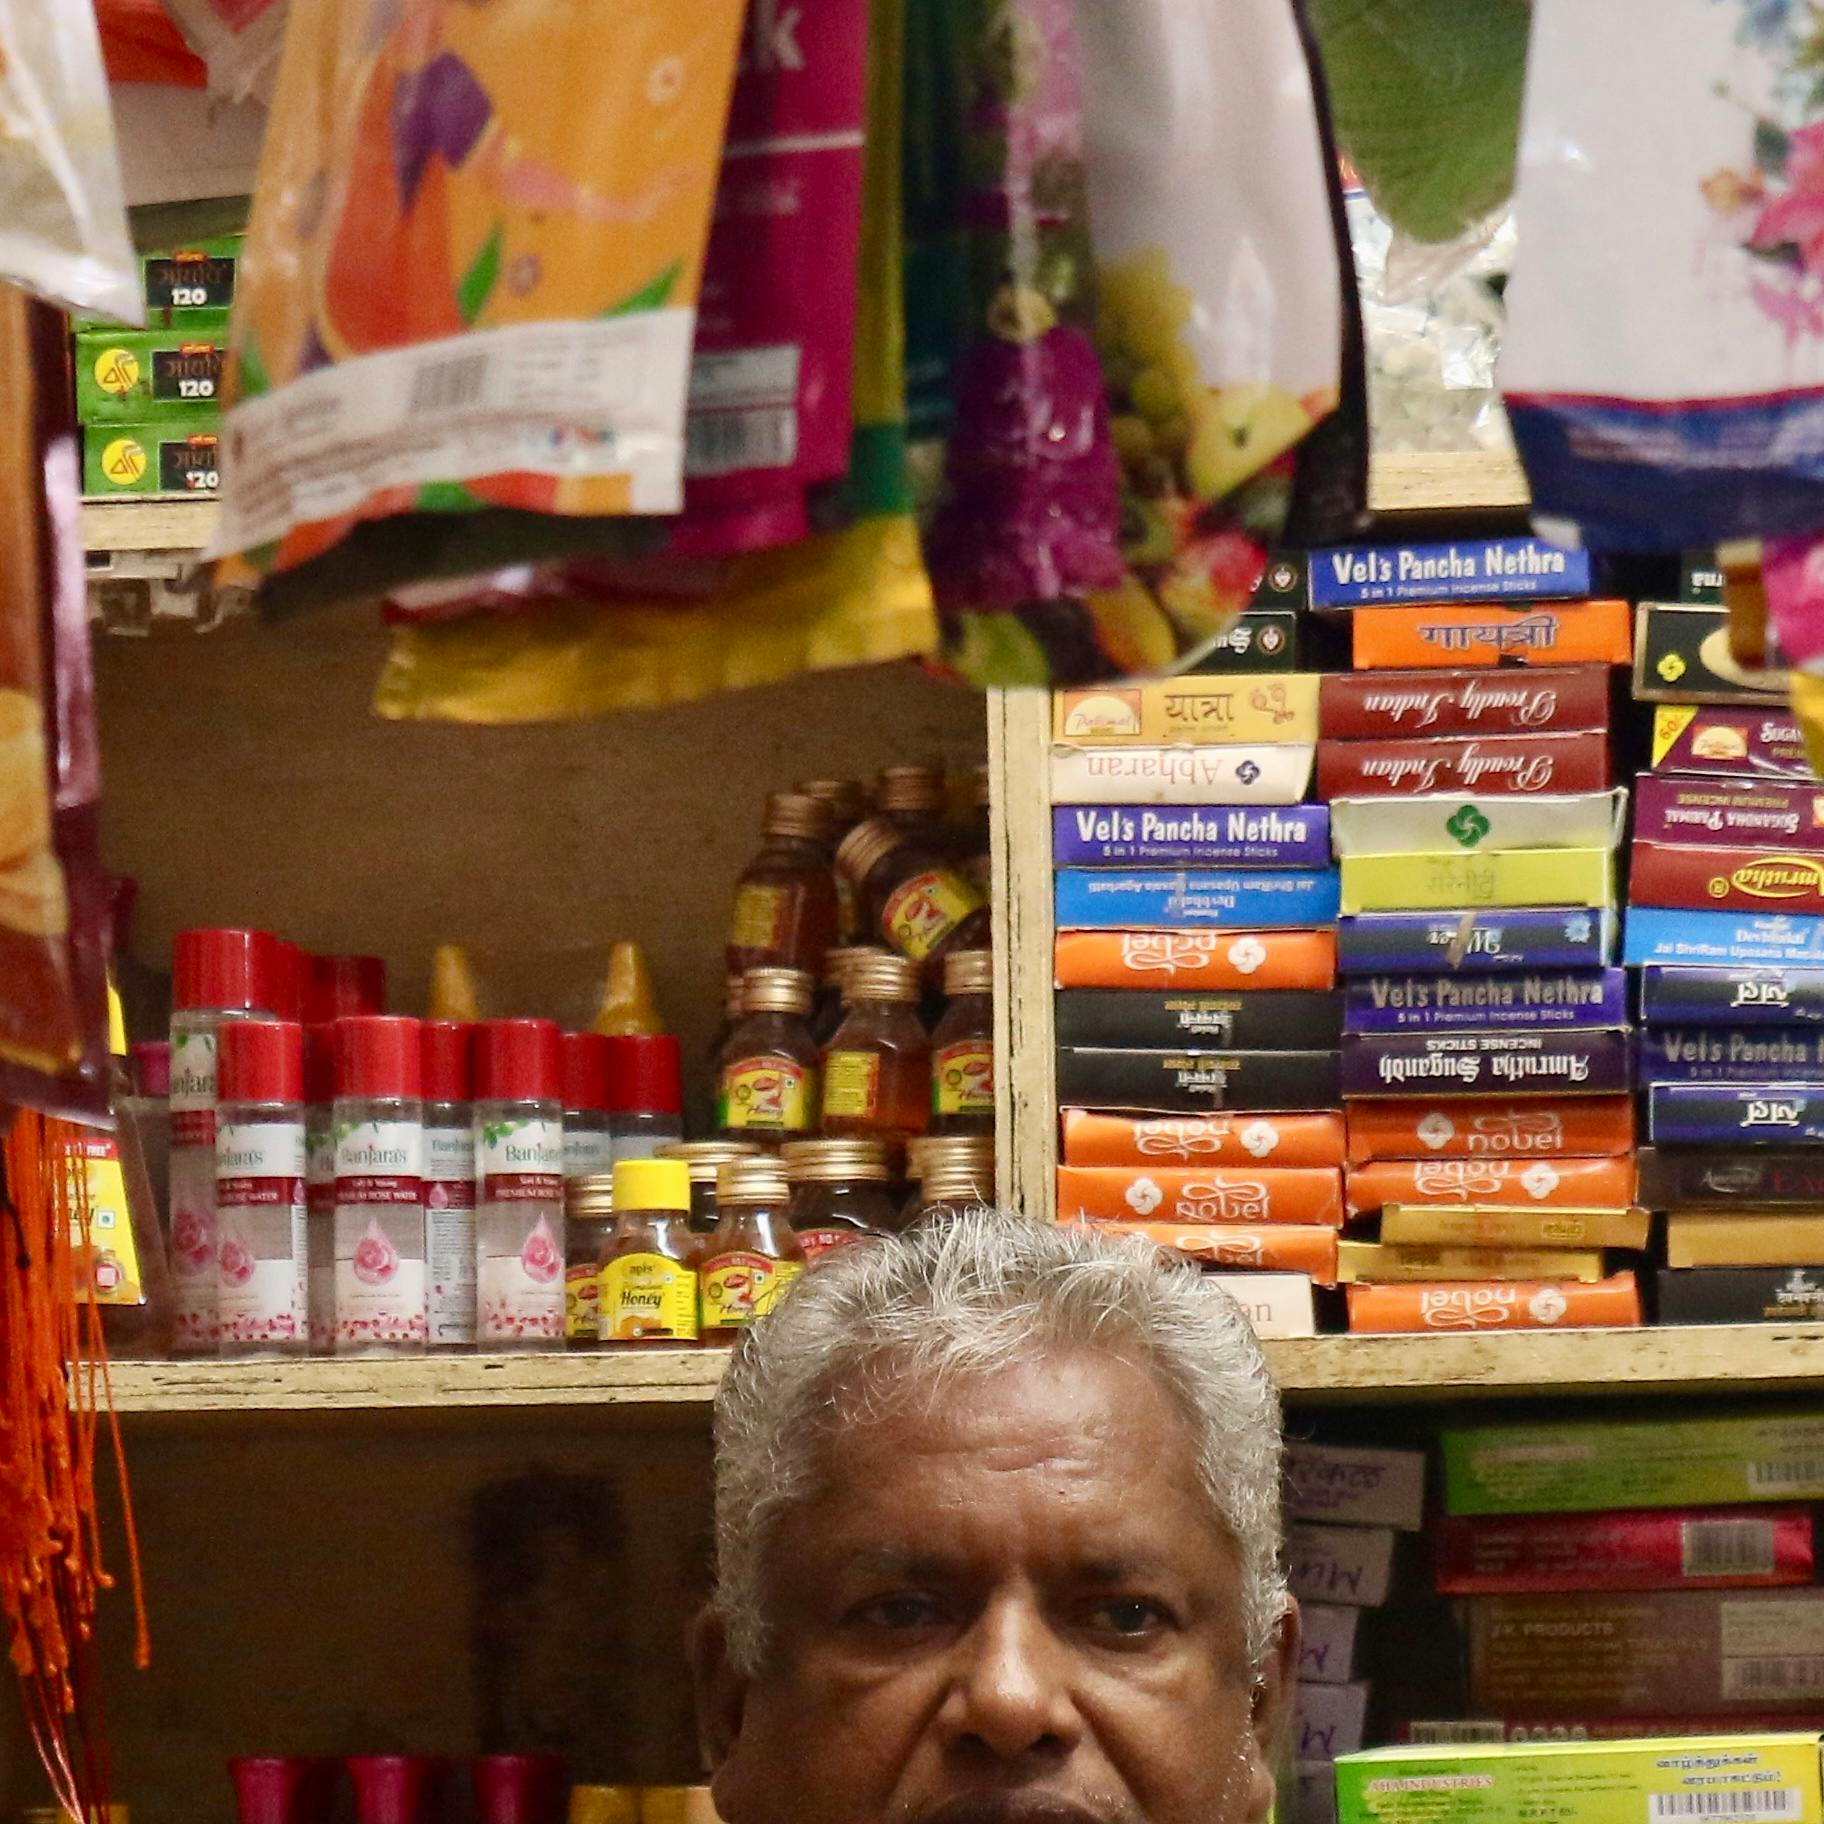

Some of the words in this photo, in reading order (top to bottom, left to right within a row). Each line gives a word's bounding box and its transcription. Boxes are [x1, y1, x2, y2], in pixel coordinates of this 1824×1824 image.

[171, 287, 208, 306] 120
[179, 379, 215, 398] 120
[186, 470, 219, 489] 120
[1332, 553, 1392, 584] Vel's
[1398, 547, 1477, 580] Pancha
[1484, 541, 1565, 576] Nethra
[1416, 612, 1560, 652] गायत्री
[1164, 692, 1234, 725] यात्रा
[1361, 688, 1451, 725] Indian
[1460, 684, 1557, 728] Proudly
[1087, 757, 1221, 786] Abharan
[1360, 752, 1449, 788] Indian
[1457, 742, 1554, 790] Proudly
[1076, 810, 1134, 843] Vel's
[1141, 811, 1218, 843] Pancha
[1226, 811, 1307, 844] Nethra
[1371, 979, 1429, 1010] Vel's
[1437, 976, 1515, 1007] Pancha
[1523, 973, 1603, 1005] Nethra
[1425, 1038, 1475, 1051] STICKS
[1478, 1038, 1542, 1051] INCENSE
[1729, 1033, 1808, 1064] Pancha
[1378, 1053, 1478, 1085] Sugandh
[1490, 1053, 1590, 1085] Amrutha
[1134, 1120, 1232, 1143] nobel
[1415, 1160, 1510, 1187] nobel
[620, 1291, 664, 1310] Honey
[1422, 1289, 1517, 1315] nobel
[1522, 1621, 1615, 1638] PRODUCTS
